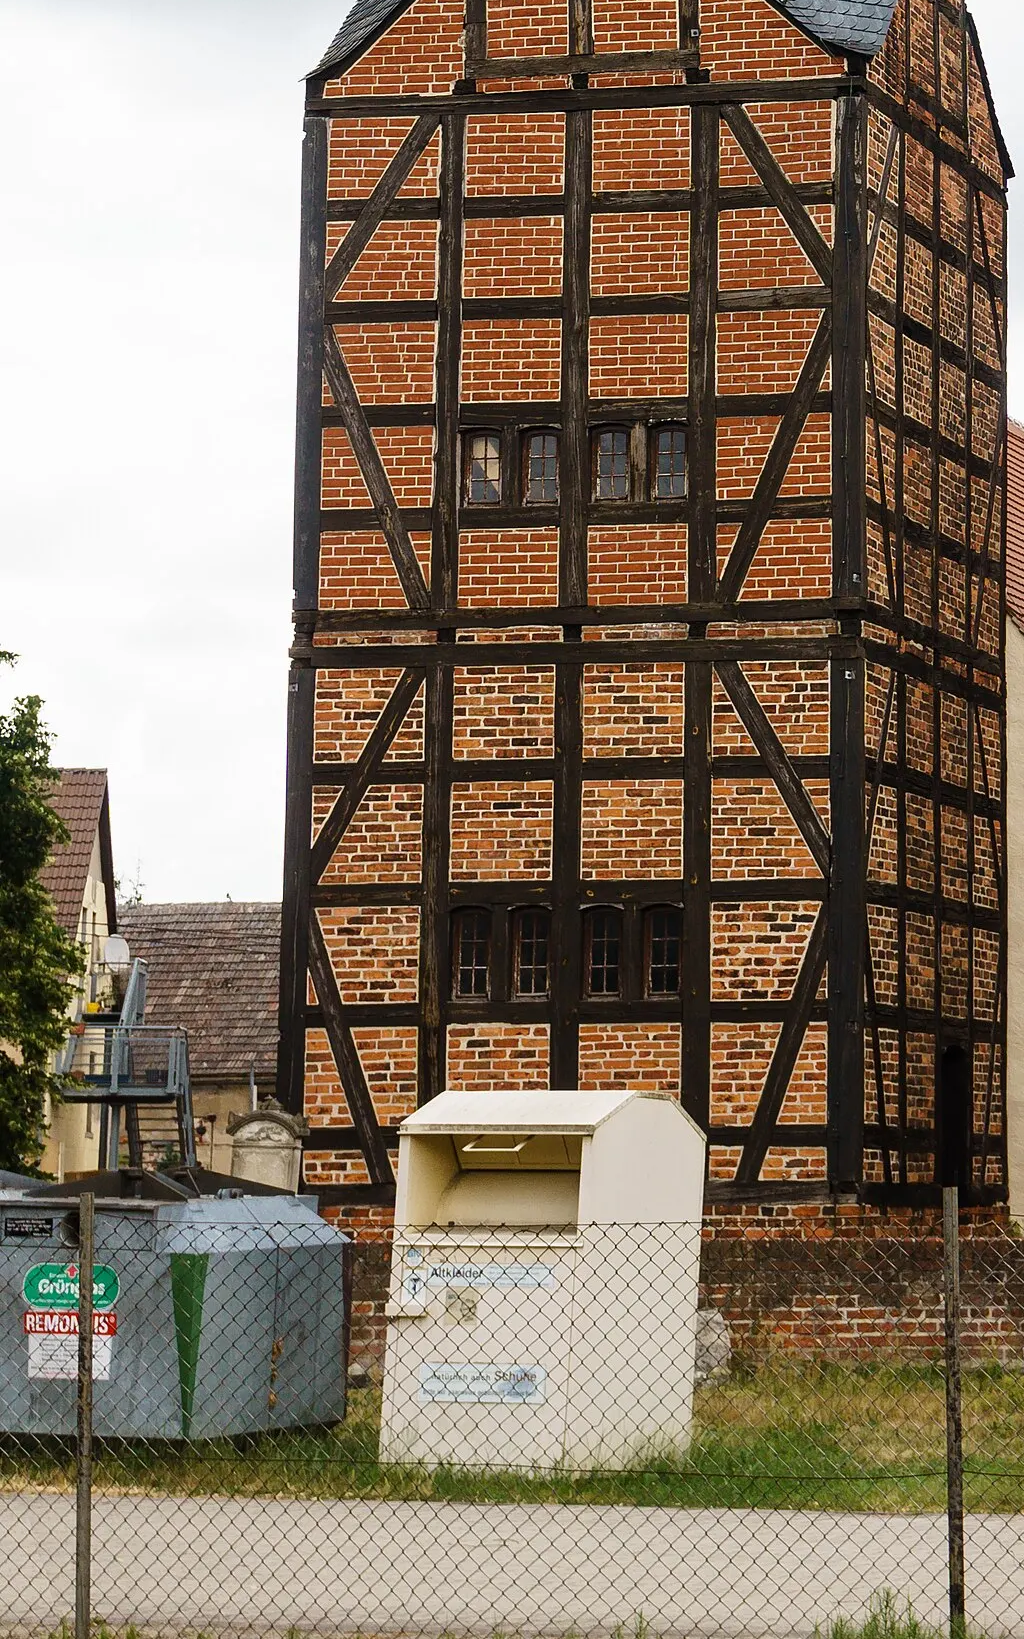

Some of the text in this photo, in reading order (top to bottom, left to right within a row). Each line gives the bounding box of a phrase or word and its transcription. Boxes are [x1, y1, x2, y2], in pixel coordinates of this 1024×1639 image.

[431, 1267, 483, 1278] Altkleider
[25, 1314, 109, 1334] REMONIS
[494, 1370, 537, 1382] Schuhe
